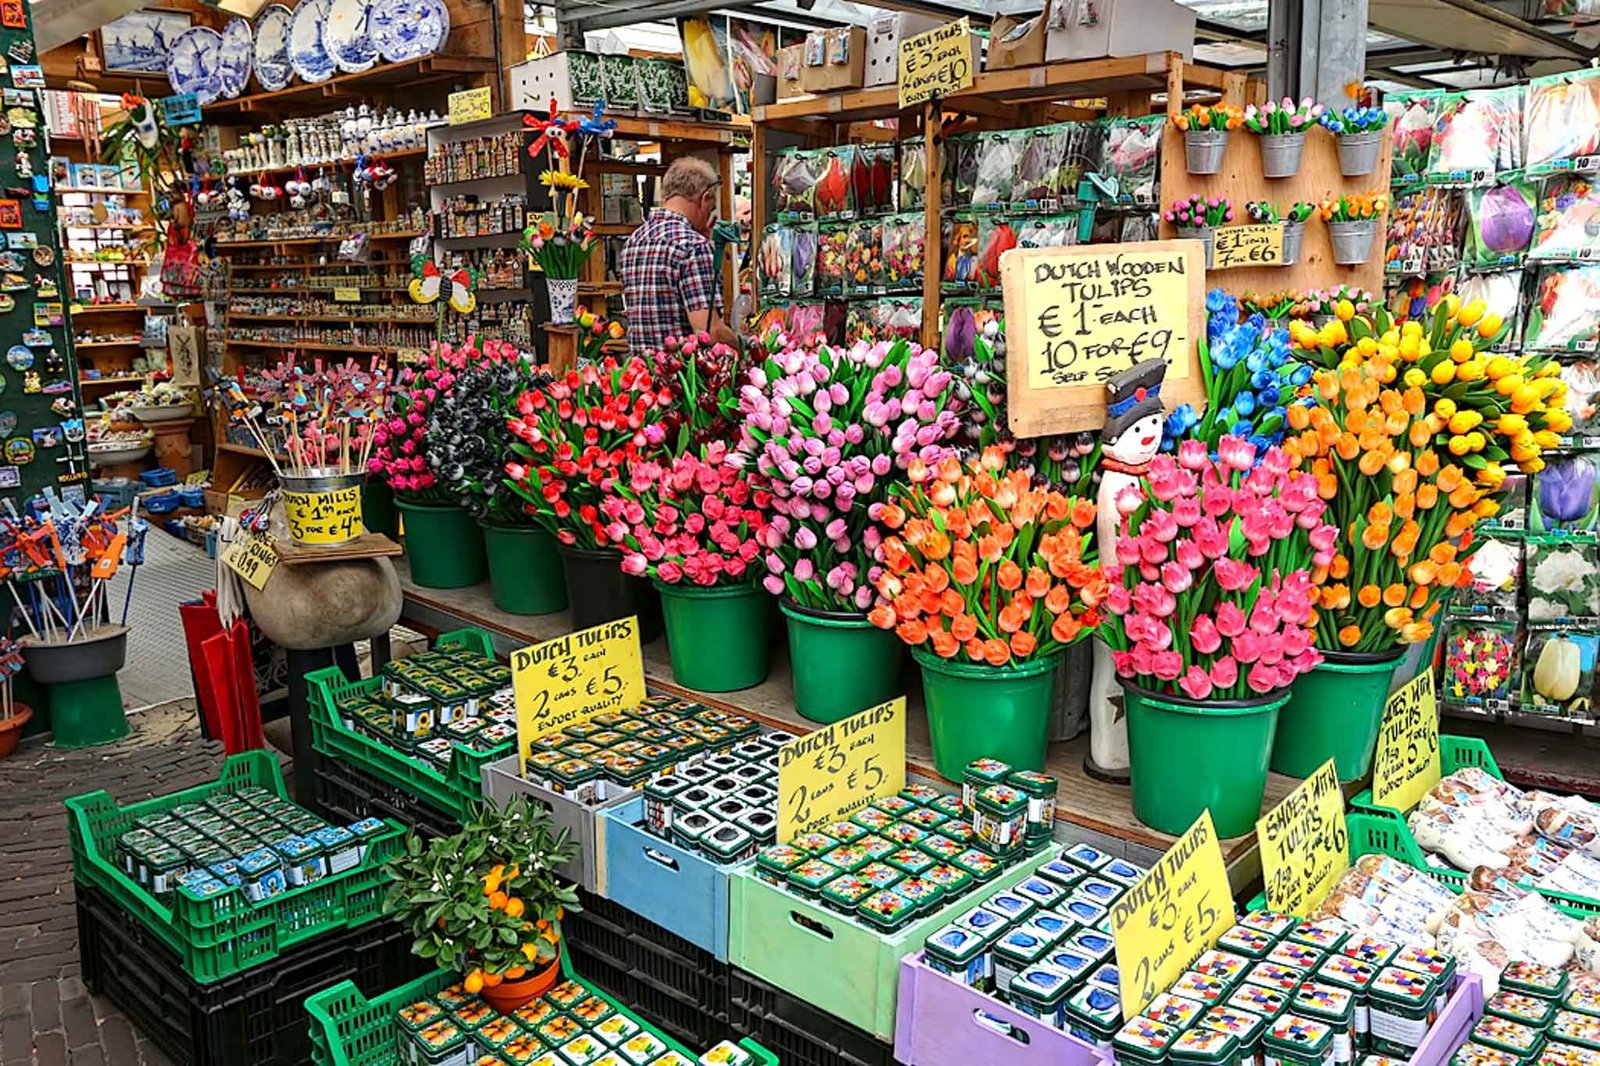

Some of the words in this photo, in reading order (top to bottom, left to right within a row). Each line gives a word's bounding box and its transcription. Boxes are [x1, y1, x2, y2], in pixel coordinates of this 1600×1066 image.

[1577, 158, 1589, 168] 10
[1473, 170, 1485, 181] 10
[1579, 249, 1591, 258] 10
[1034, 260, 1101, 283] DUTCH
[1106, 253, 1185, 277] WOODEN
[1100, 305, 1157, 325] EACH
[1041, 340, 1077, 375] 10
[1082, 337, 1131, 360] FOR
[318, 489, 356, 505] MILLS
[290, 519, 304, 539] 3
[306, 526, 324, 534] FOR
[249, 543, 278, 568] RINGS
[1495, 607, 1505, 615] 10
[515, 636, 571, 672] DUTCH
[531, 689, 551, 721] 2
[1488, 700, 1499, 708] 10
[537, 709, 578, 731] EXPORT
[780, 725, 835, 767] DUTCH
[788, 785, 811, 824] 2
[1112, 862, 1167, 930] DUTCH
[1135, 955, 1156, 1007] 2
